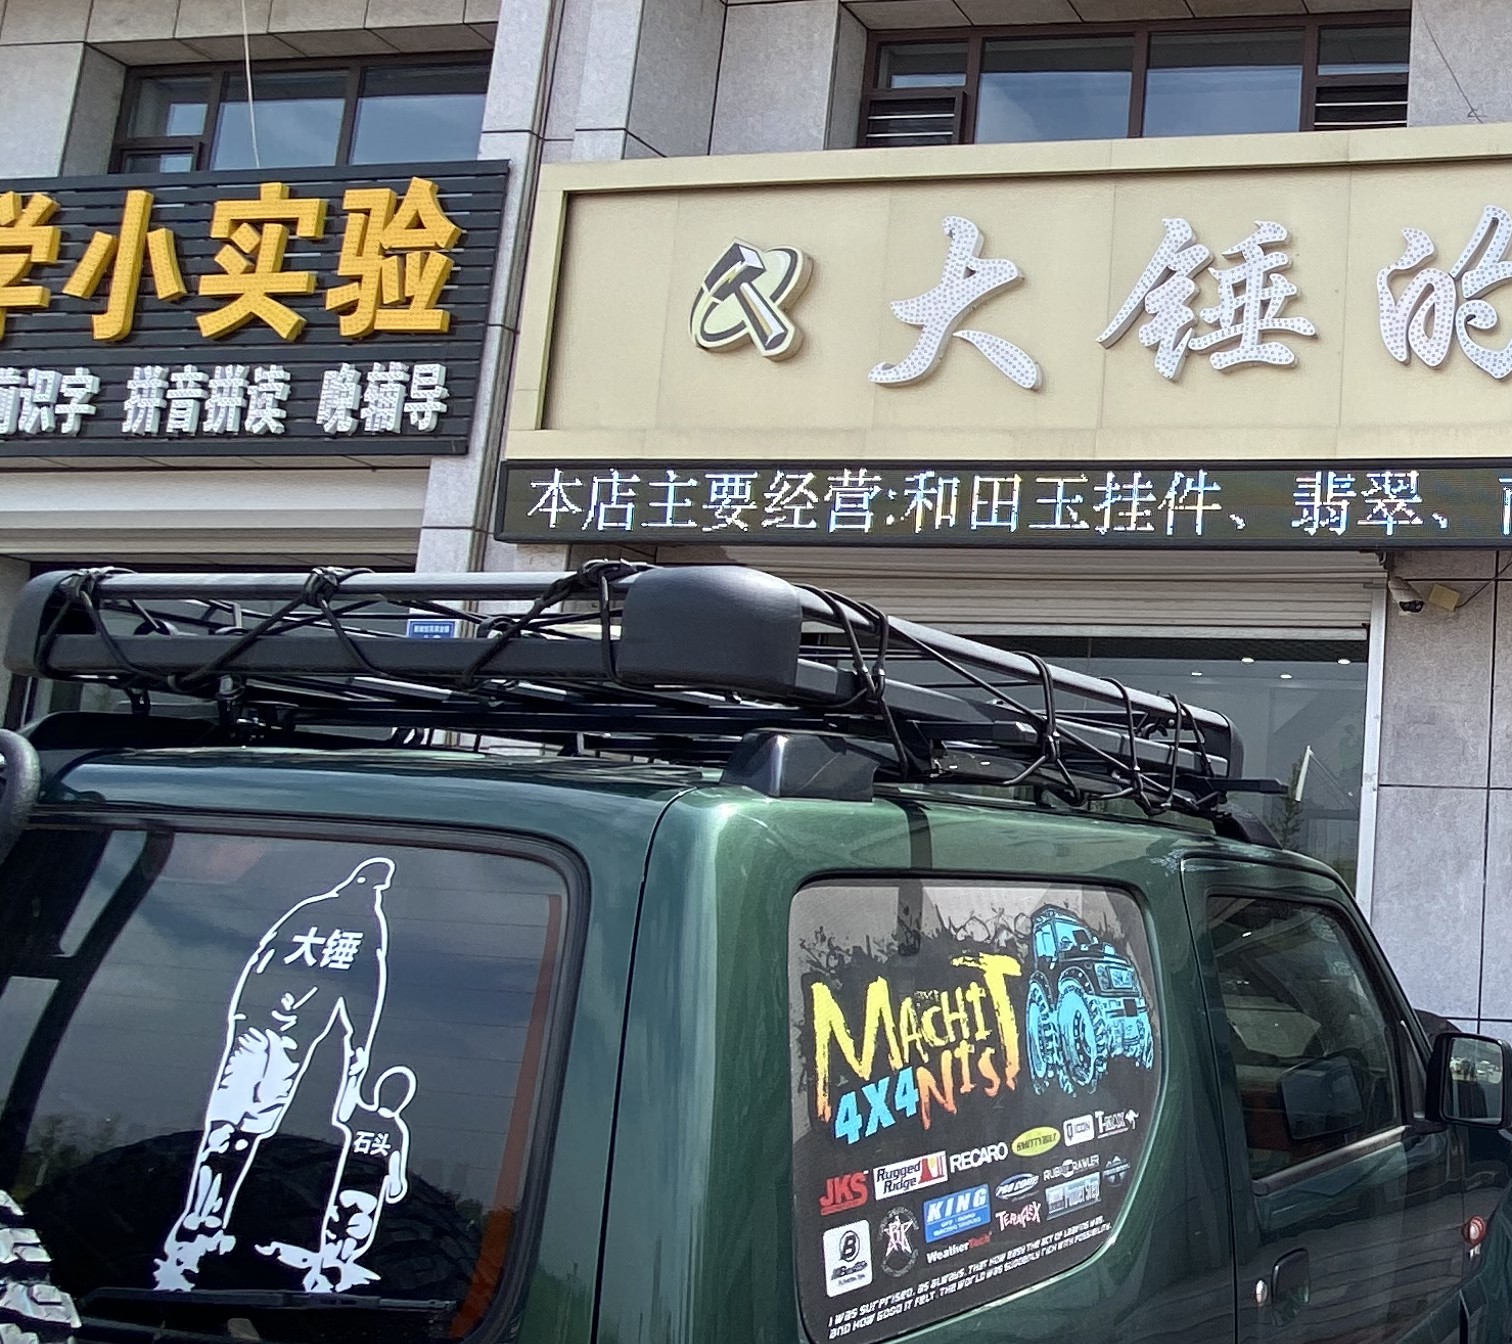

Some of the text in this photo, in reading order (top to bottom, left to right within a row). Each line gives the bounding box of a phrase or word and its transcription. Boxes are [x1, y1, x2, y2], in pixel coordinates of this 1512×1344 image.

[122, 363, 292, 437] 拼音拼读
[316, 361, 451, 434] 晚辅导
[283, 928, 364, 970] 大锤
[835, 1067, 920, 1145] 4X4
[352, 1130, 391, 1157] 石头
[949, 1141, 1009, 1173] RECARO
[876, 1160, 922, 1182] Rugged
[883, 1176, 917, 1194] Ridge
[819, 1171, 868, 1214] JKS
[927, 1187, 988, 1222] KING
